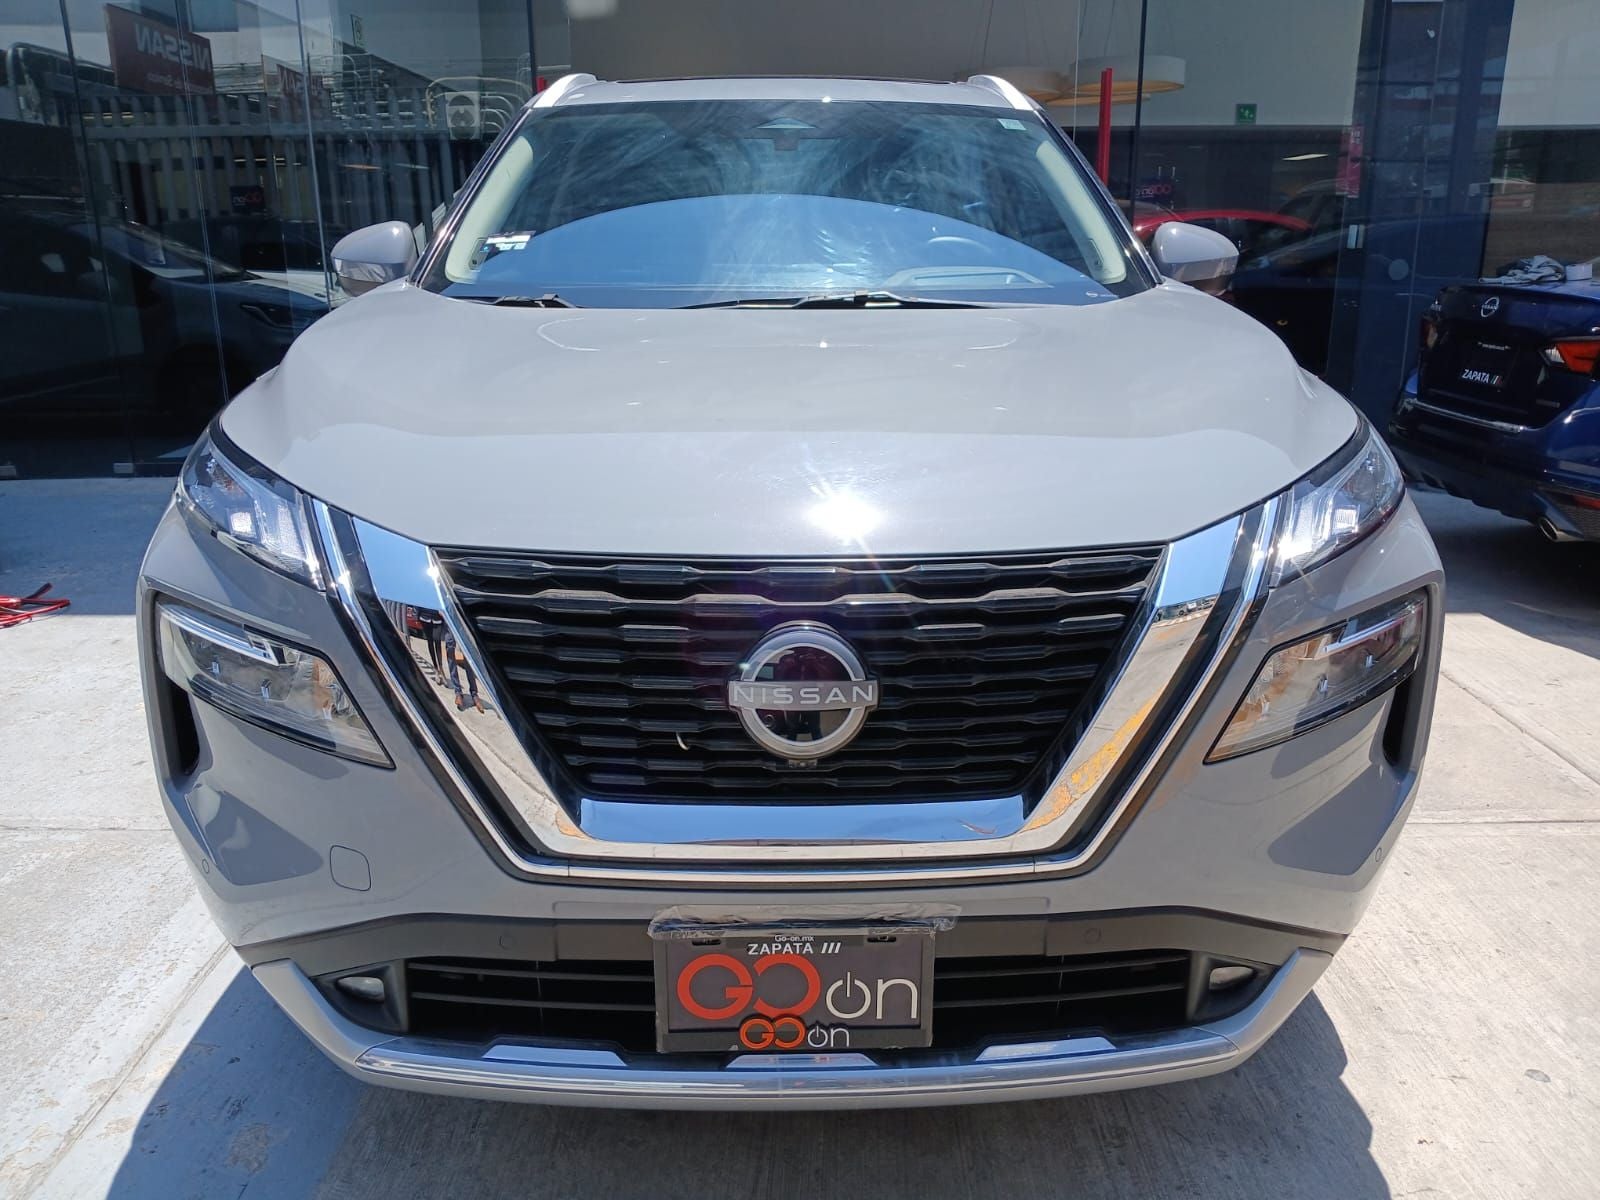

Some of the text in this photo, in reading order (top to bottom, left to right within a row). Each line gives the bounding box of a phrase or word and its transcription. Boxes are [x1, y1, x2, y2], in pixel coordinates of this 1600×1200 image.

[1462, 368, 1490, 384] ZAPATA
[732, 684, 873, 705] NISSAN
[747, 942, 814, 955] ZAPATA
